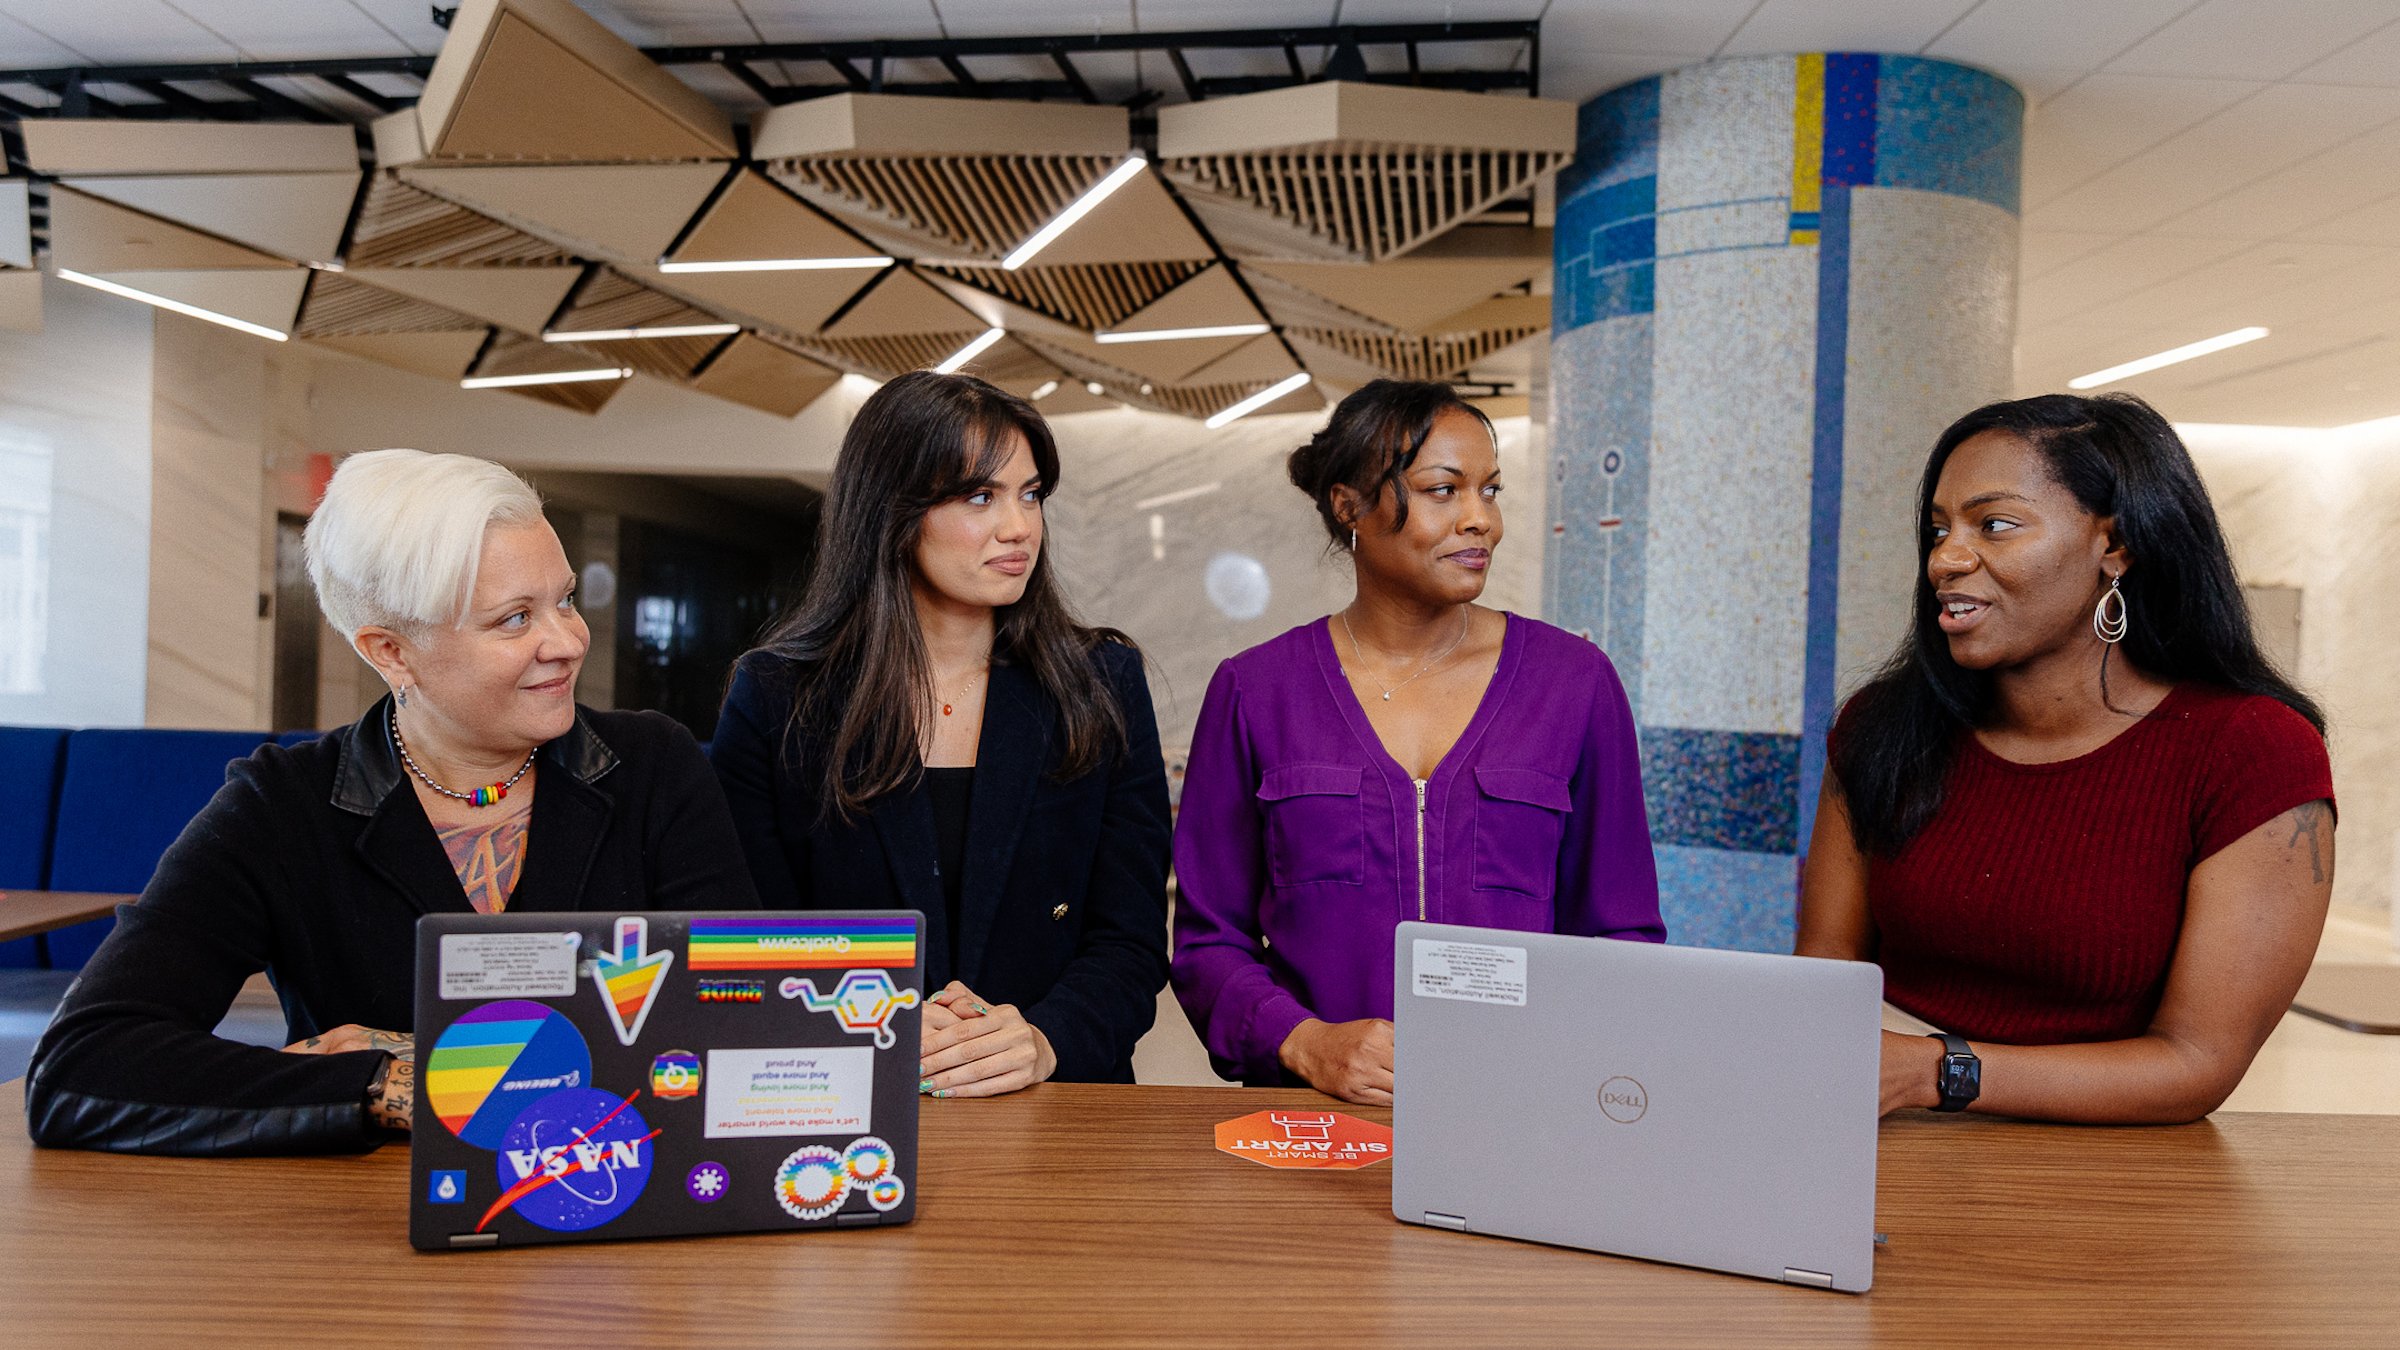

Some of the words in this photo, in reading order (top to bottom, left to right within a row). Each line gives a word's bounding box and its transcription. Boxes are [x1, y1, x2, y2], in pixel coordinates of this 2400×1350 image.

[757, 935, 852, 953] Qualcomm
[766, 1060, 794, 1069] proud
[797, 1060, 817, 1068] And
[664, 1061, 689, 1089] Q
[752, 1072, 780, 1081] equal
[809, 1072, 830, 1080] And
[751, 1084, 780, 1093] loving
[1605, 1092, 1643, 1107] DELL
[745, 1108, 785, 1116] tolerant
[718, 1121, 756, 1129] smarter
[759, 1120, 787, 1128] world
[808, 1118, 834, 1126] make
[836, 1118, 860, 1126] Let's
[1231, 1140, 1333, 1151] APART
[1341, 1142, 1388, 1152] SIT
[505, 1139, 641, 1179] NASA
[1333, 1152, 1358, 1160] BE
